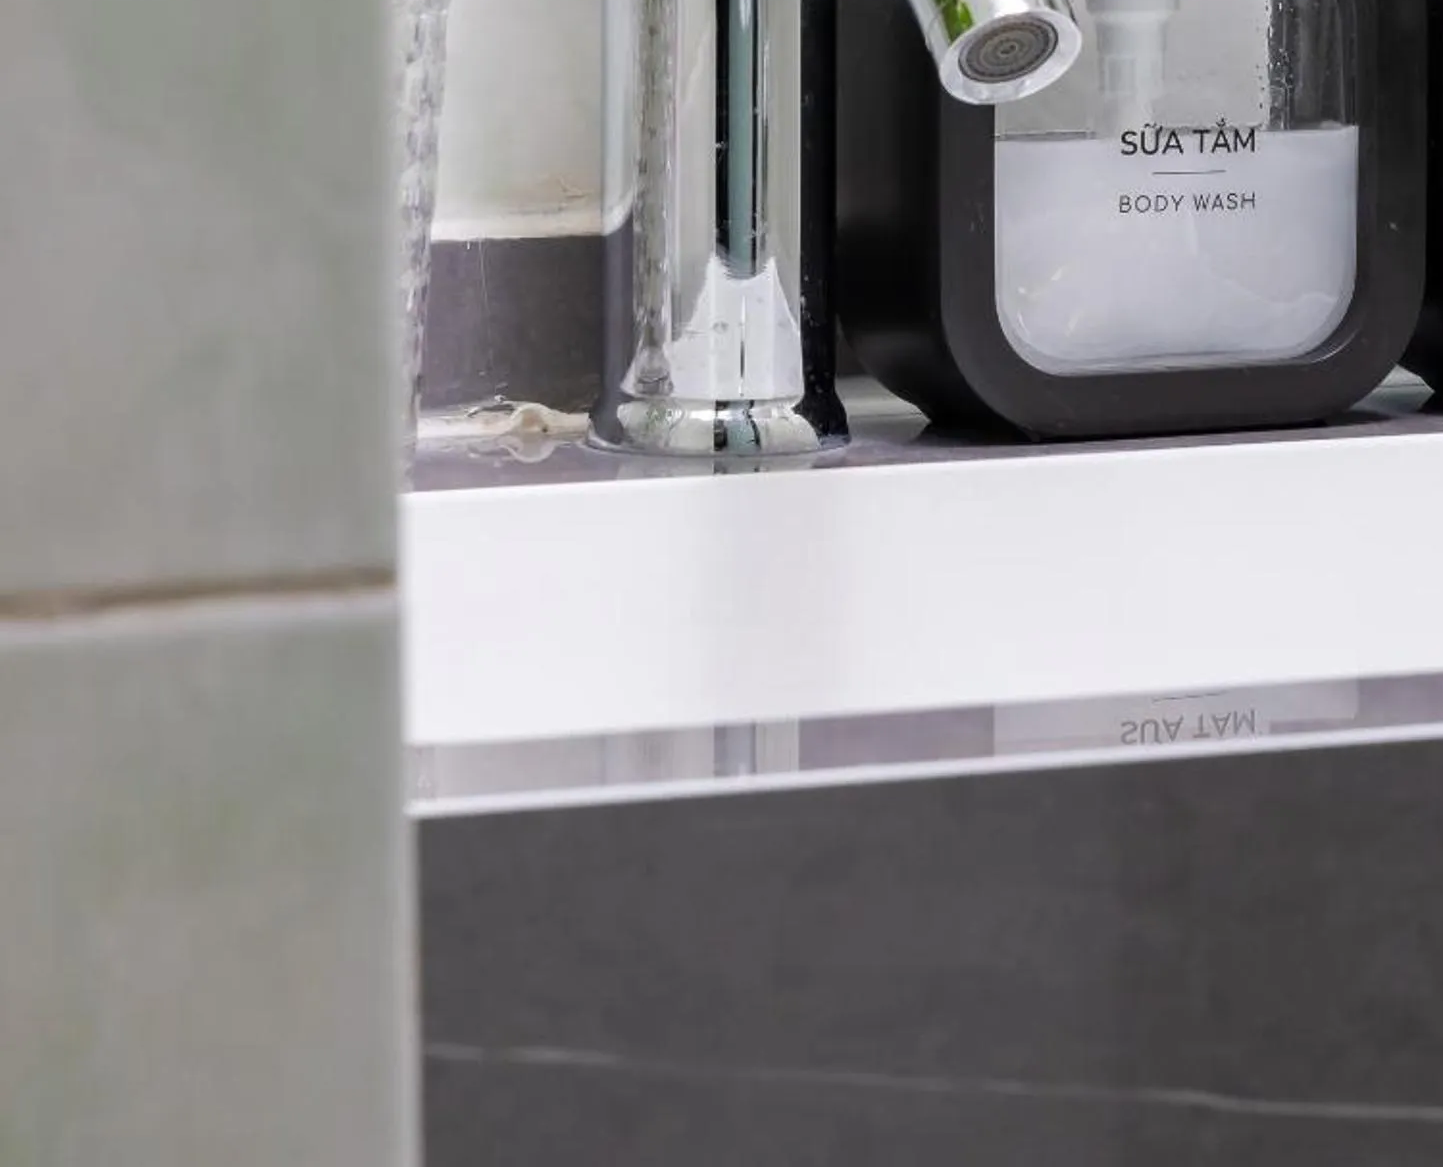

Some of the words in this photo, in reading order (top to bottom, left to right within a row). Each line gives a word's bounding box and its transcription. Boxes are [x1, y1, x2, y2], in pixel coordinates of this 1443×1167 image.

[1120, 123, 1184, 156] SỮA
[1192, 117, 1256, 154] TẮM
[1119, 194, 1184, 214] BODY
[1193, 191, 1256, 212] WASH
